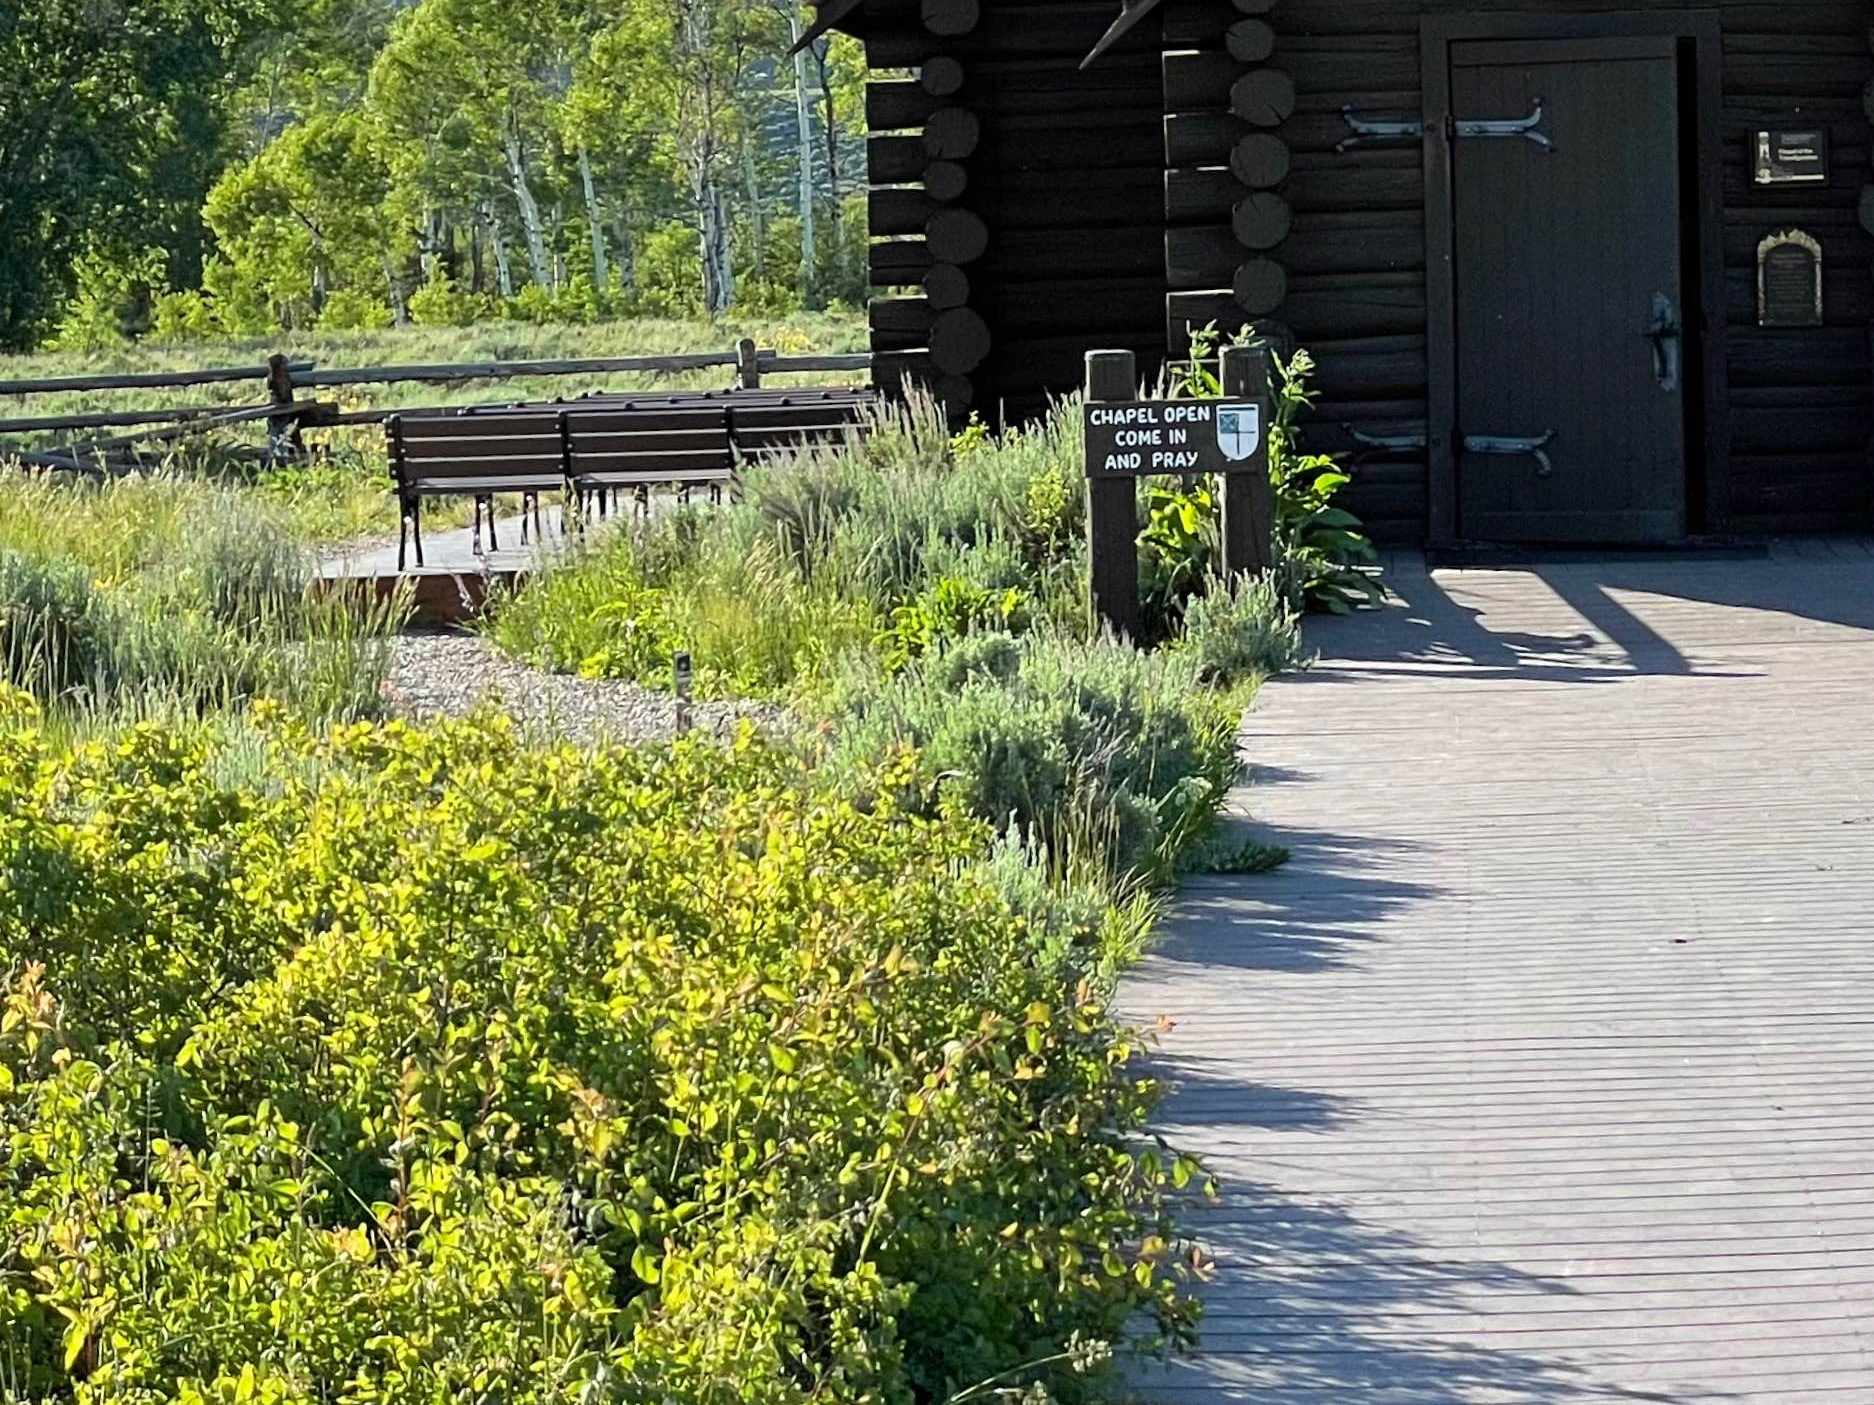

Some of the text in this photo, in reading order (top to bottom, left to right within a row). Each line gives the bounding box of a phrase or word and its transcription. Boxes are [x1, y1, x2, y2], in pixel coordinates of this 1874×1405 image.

[1090, 406, 1211, 425] CHAPEL OPEN
[1115, 429, 1187, 447] COME IN
[1105, 451, 1198, 470] AND PRAY
